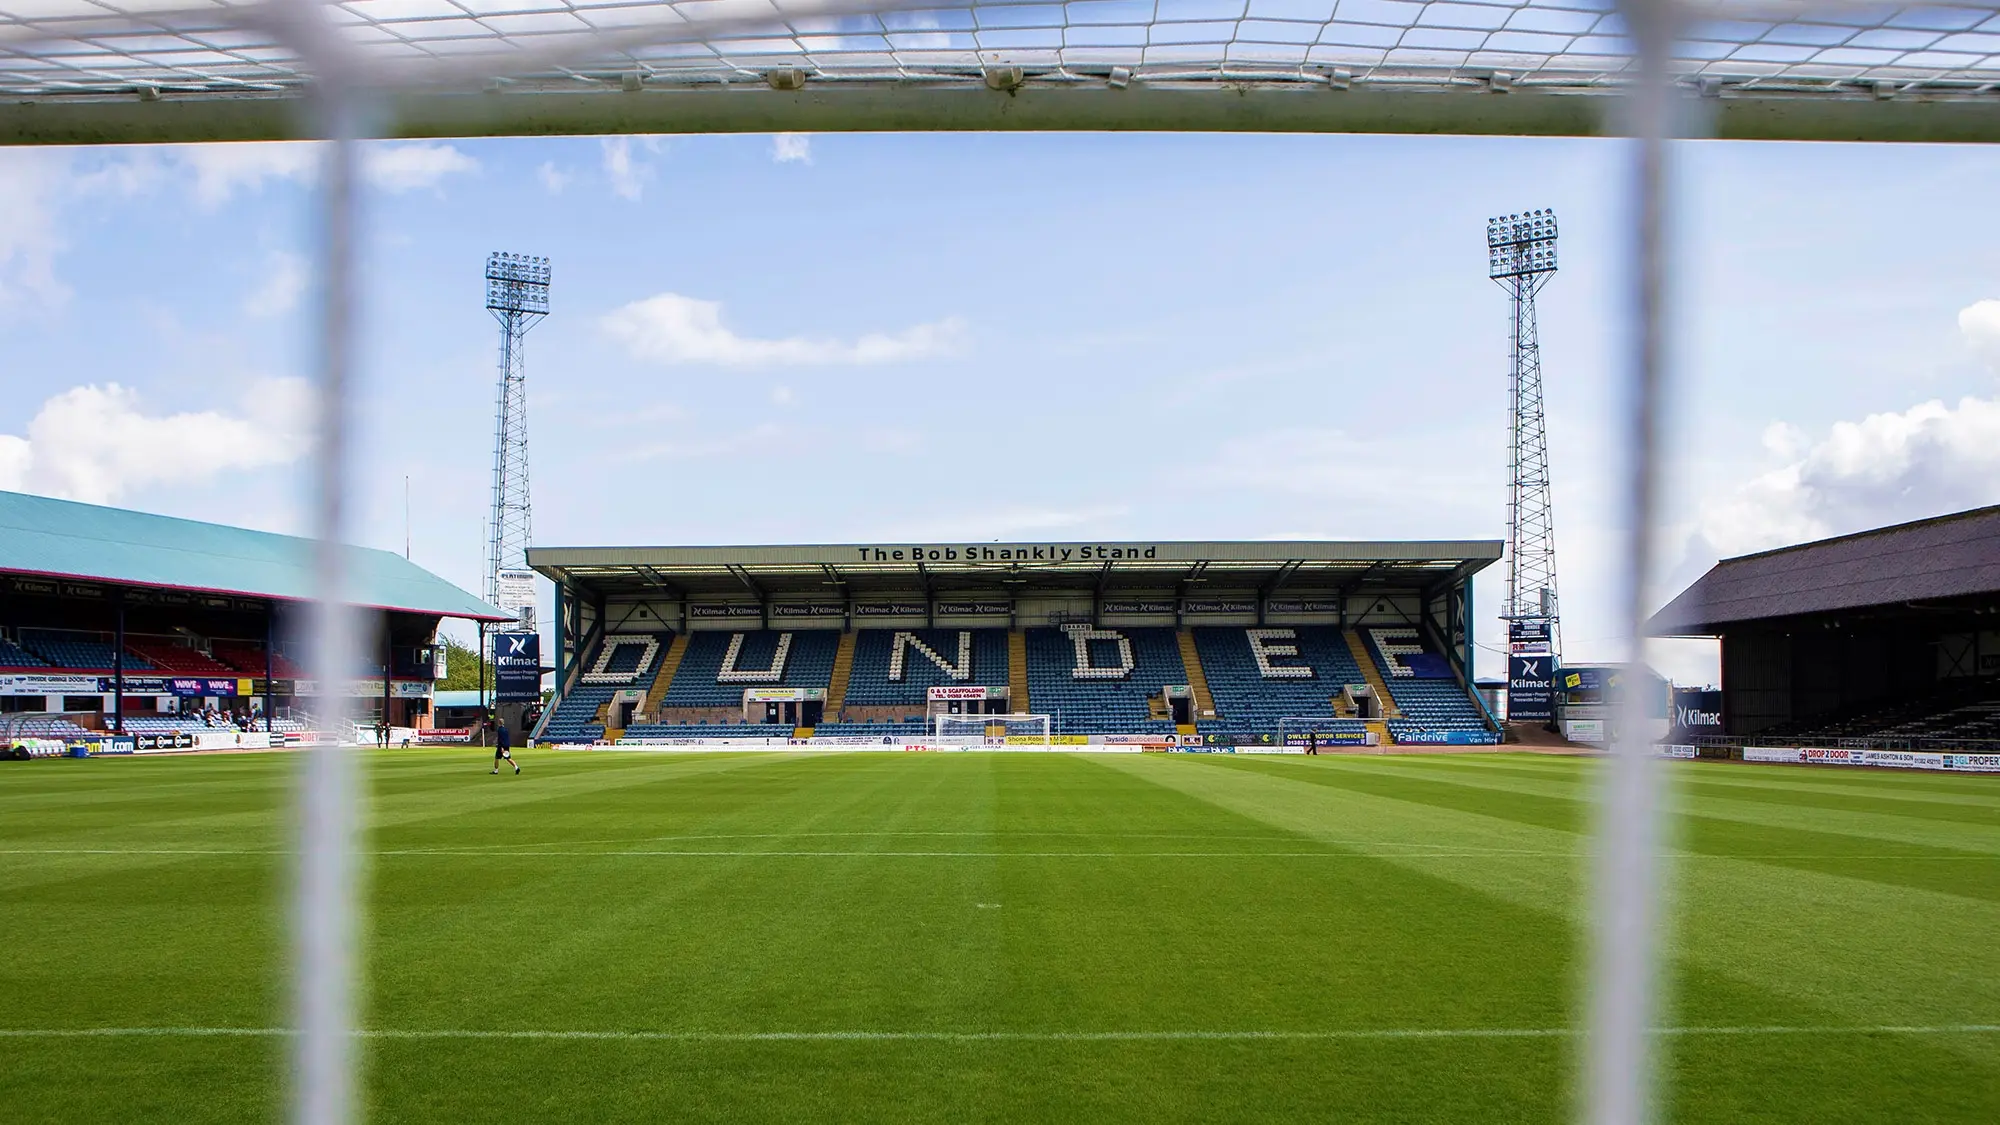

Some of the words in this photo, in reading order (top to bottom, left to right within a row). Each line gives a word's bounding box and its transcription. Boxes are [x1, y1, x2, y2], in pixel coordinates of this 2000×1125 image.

[859, 548, 904, 561] The
[912, 547, 957, 561] Bob
[965, 546, 1072, 562] Shankly
[1080, 546, 1157, 560] Stand
[1277, 603, 1302, 611] Kilmac
[498, 656, 537, 666] Kilmac
[174, 680, 196, 688] WAVE
[208, 680, 229, 689] WAVE
[1511, 679, 1549, 688] Kilmac
[1688, 709, 1721, 725] Kilmac
[1398, 732, 1448, 742] Fairdrive
[1825, 750, 1830, 758] 2
[1830, 750, 1849, 758] DOOR
